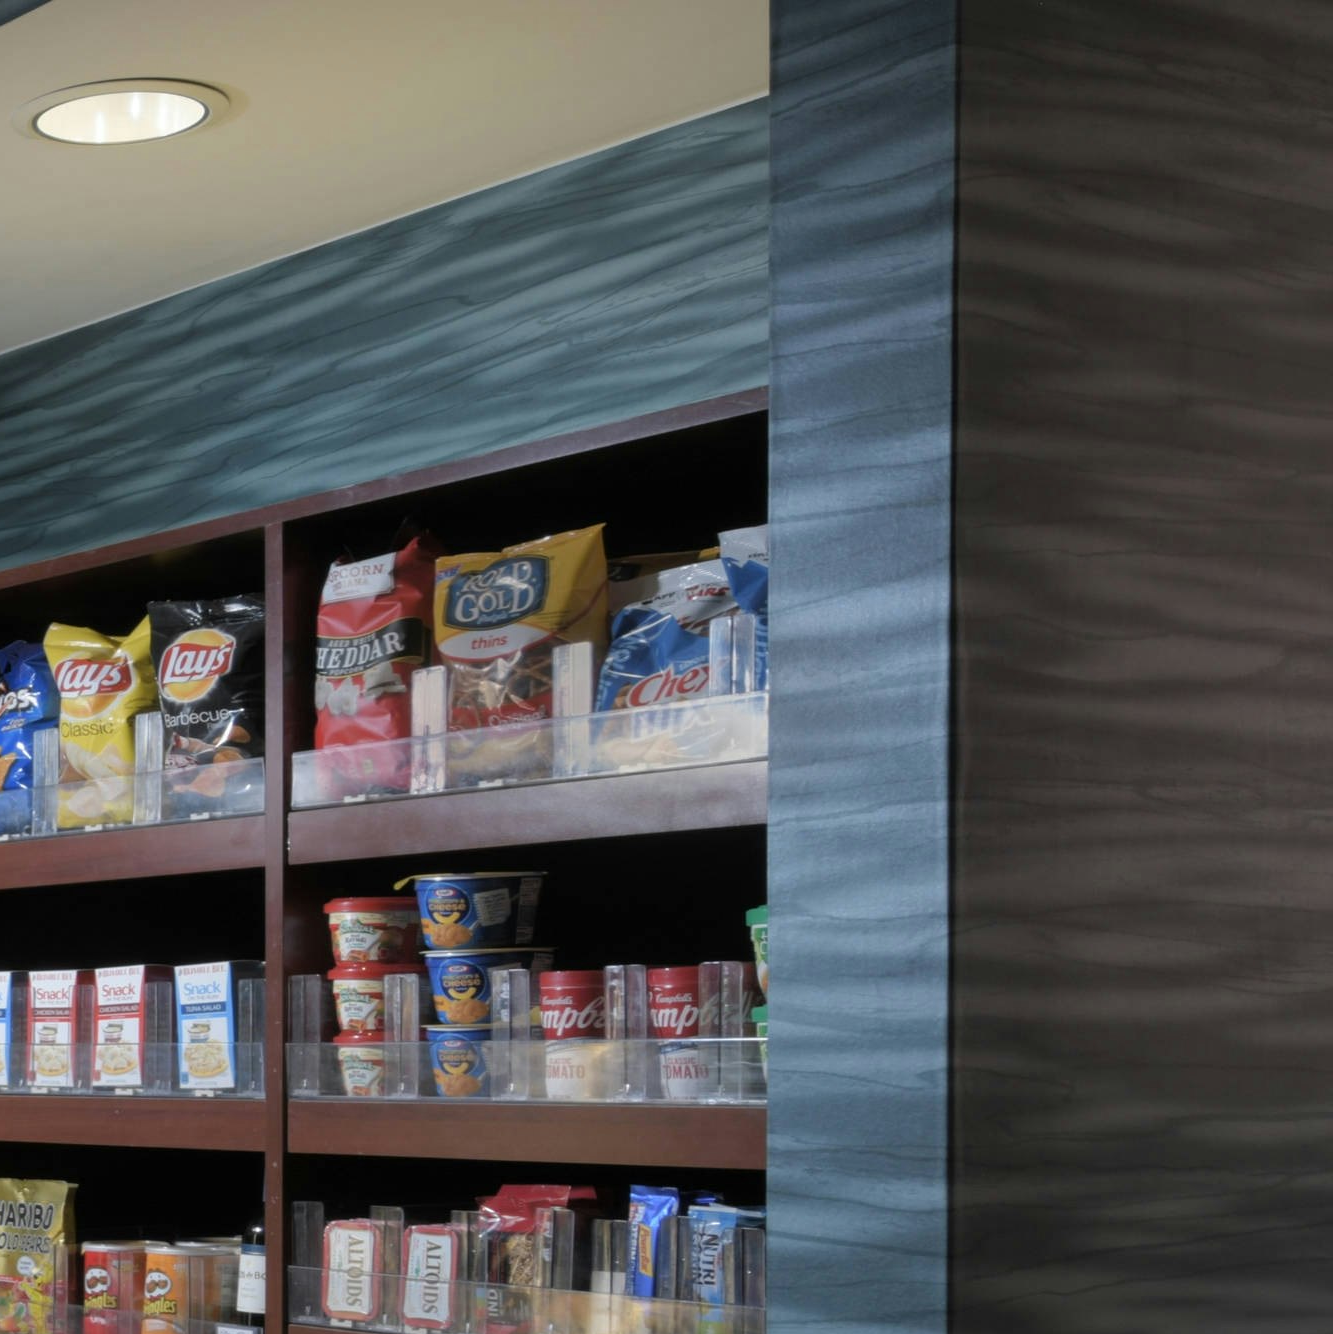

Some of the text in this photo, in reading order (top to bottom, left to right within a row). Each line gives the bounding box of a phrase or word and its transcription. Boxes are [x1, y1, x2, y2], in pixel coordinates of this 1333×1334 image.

[461, 560, 533, 592] ROLD
[454, 584, 534, 623] GOLD
[316, 630, 405, 669] HEDDAR
[471, 632, 508, 650] thins
[163, 642, 233, 685] Lay's
[61, 721, 114, 739] Classic
[165, 708, 230, 728] Barbecue
[36, 987, 69, 1000] Snack
[101, 983, 136, 997] Snack
[183, 981, 221, 995] Snack
[345, 1235, 365, 1307] ALTOIDS
[700, 1233, 719, 1287] NUTRI
[423, 1240, 442, 1315] ALTOIDS
[488, 1288, 498, 1317] IND
